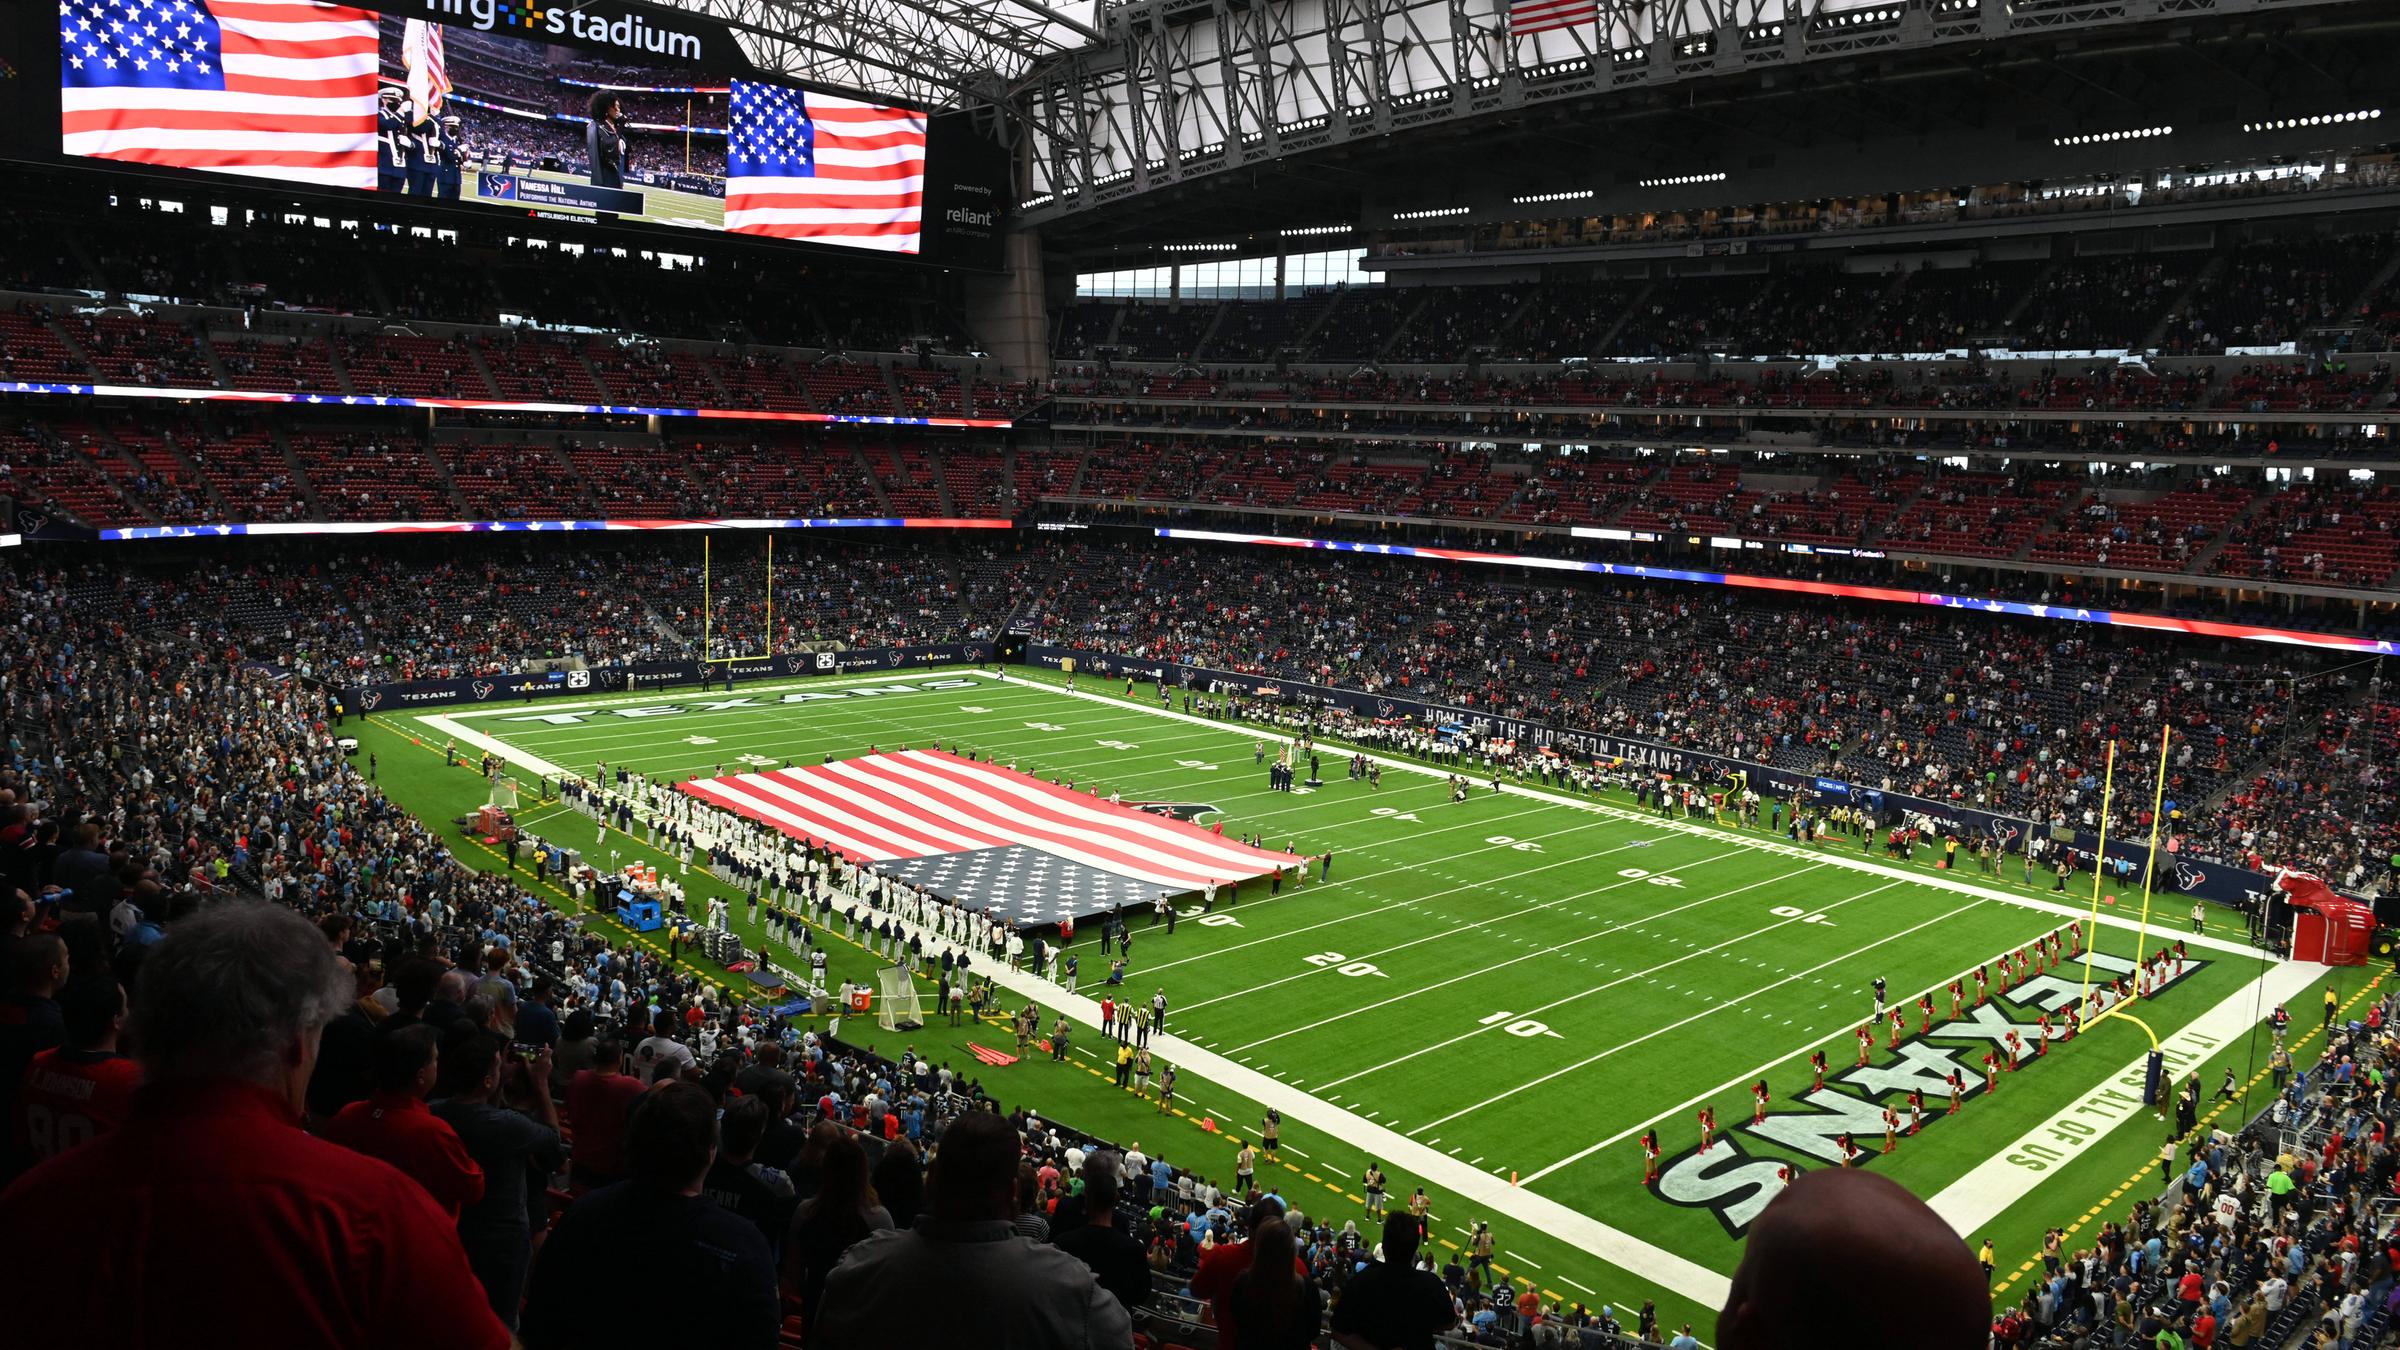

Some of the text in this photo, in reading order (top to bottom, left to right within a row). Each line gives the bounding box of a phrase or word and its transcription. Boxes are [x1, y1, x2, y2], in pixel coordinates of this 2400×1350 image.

[546, 8, 701, 60] stadium
[520, 180, 566, 195] VANESSA HILL
[954, 184, 991, 196] powered by
[519, 192, 548, 204] PERFORMING
[557, 197, 579, 207] NATIONAL
[579, 199, 598, 208] ANTHEM
[537, 210, 598, 225] MITSUBISHI ELECTRIC
[946, 207, 992, 226] reliant
[915, 653, 951, 661] TEANS
[637, 671, 683, 682] TEXANS
[731, 665, 774, 674] TEXANS
[401, 690, 457, 701] TEXANS
[498, 679, 981, 725] TEXANS
[1425, 708, 1465, 724] HOME
[1499, 720, 1526, 739] THE
[1617, 742, 1682, 772] TEXANS
[1769, 780, 1822, 798] TEXS
[1617, 868, 1683, 887] 20
[1176, 905, 1238, 927] 30
[1770, 906, 1829, 924] 10
[1302, 951, 1379, 977] 20
[854, 998, 862, 1006] G
[1478, 1011, 1550, 1037] 10
[2180, 1032, 2221, 1050] IT
[1652, 950, 2210, 1236] TEXANS
[2075, 1088, 2140, 1119] ALL
[2046, 1119, 2097, 1146] OF
[2005, 1143, 2065, 1171] US
[2220, 1202, 2235, 1215] 00
[1345, 1240, 1355, 1249] 31
[1496, 1293, 1512, 1307] 22
